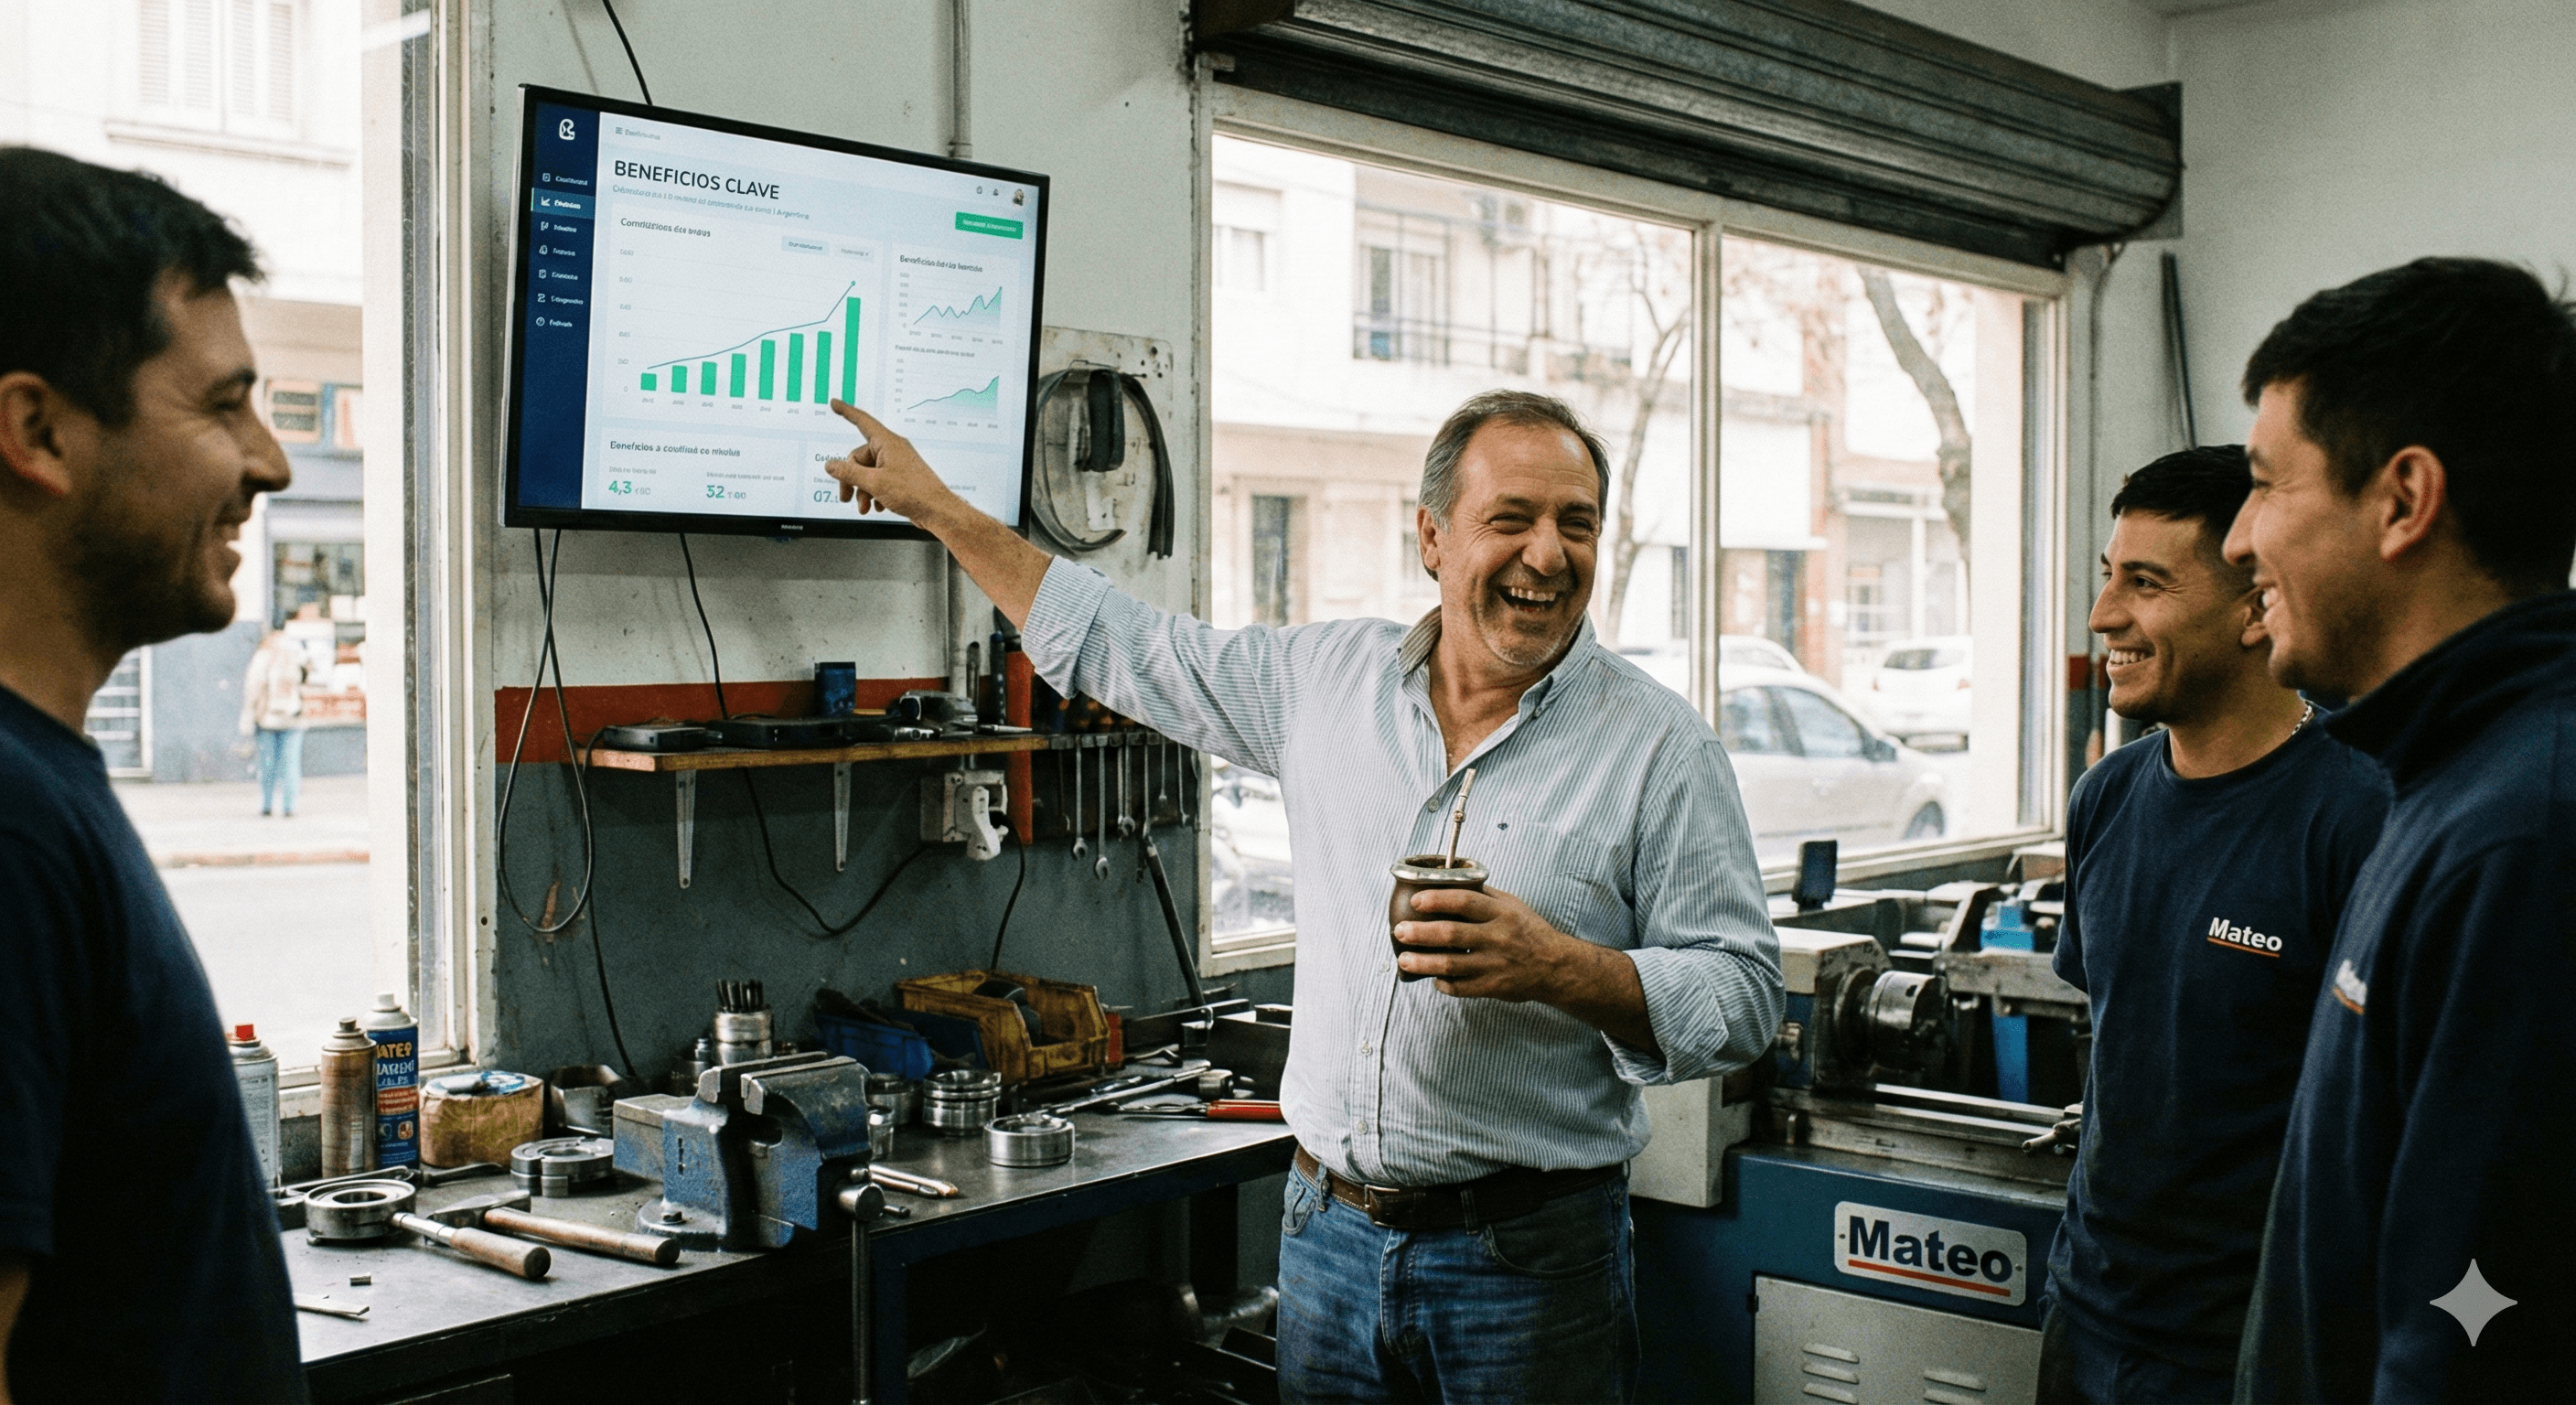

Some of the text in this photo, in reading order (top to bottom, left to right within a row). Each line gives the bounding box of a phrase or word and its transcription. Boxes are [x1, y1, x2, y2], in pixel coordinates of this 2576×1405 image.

[614, 159, 721, 191] BENEFICIOS
[724, 177, 780, 199] CLAVE
[608, 480, 632, 496] 4,3
[2208, 917, 2282, 951] Mateo
[1849, 1215, 2013, 1283] Mateo
